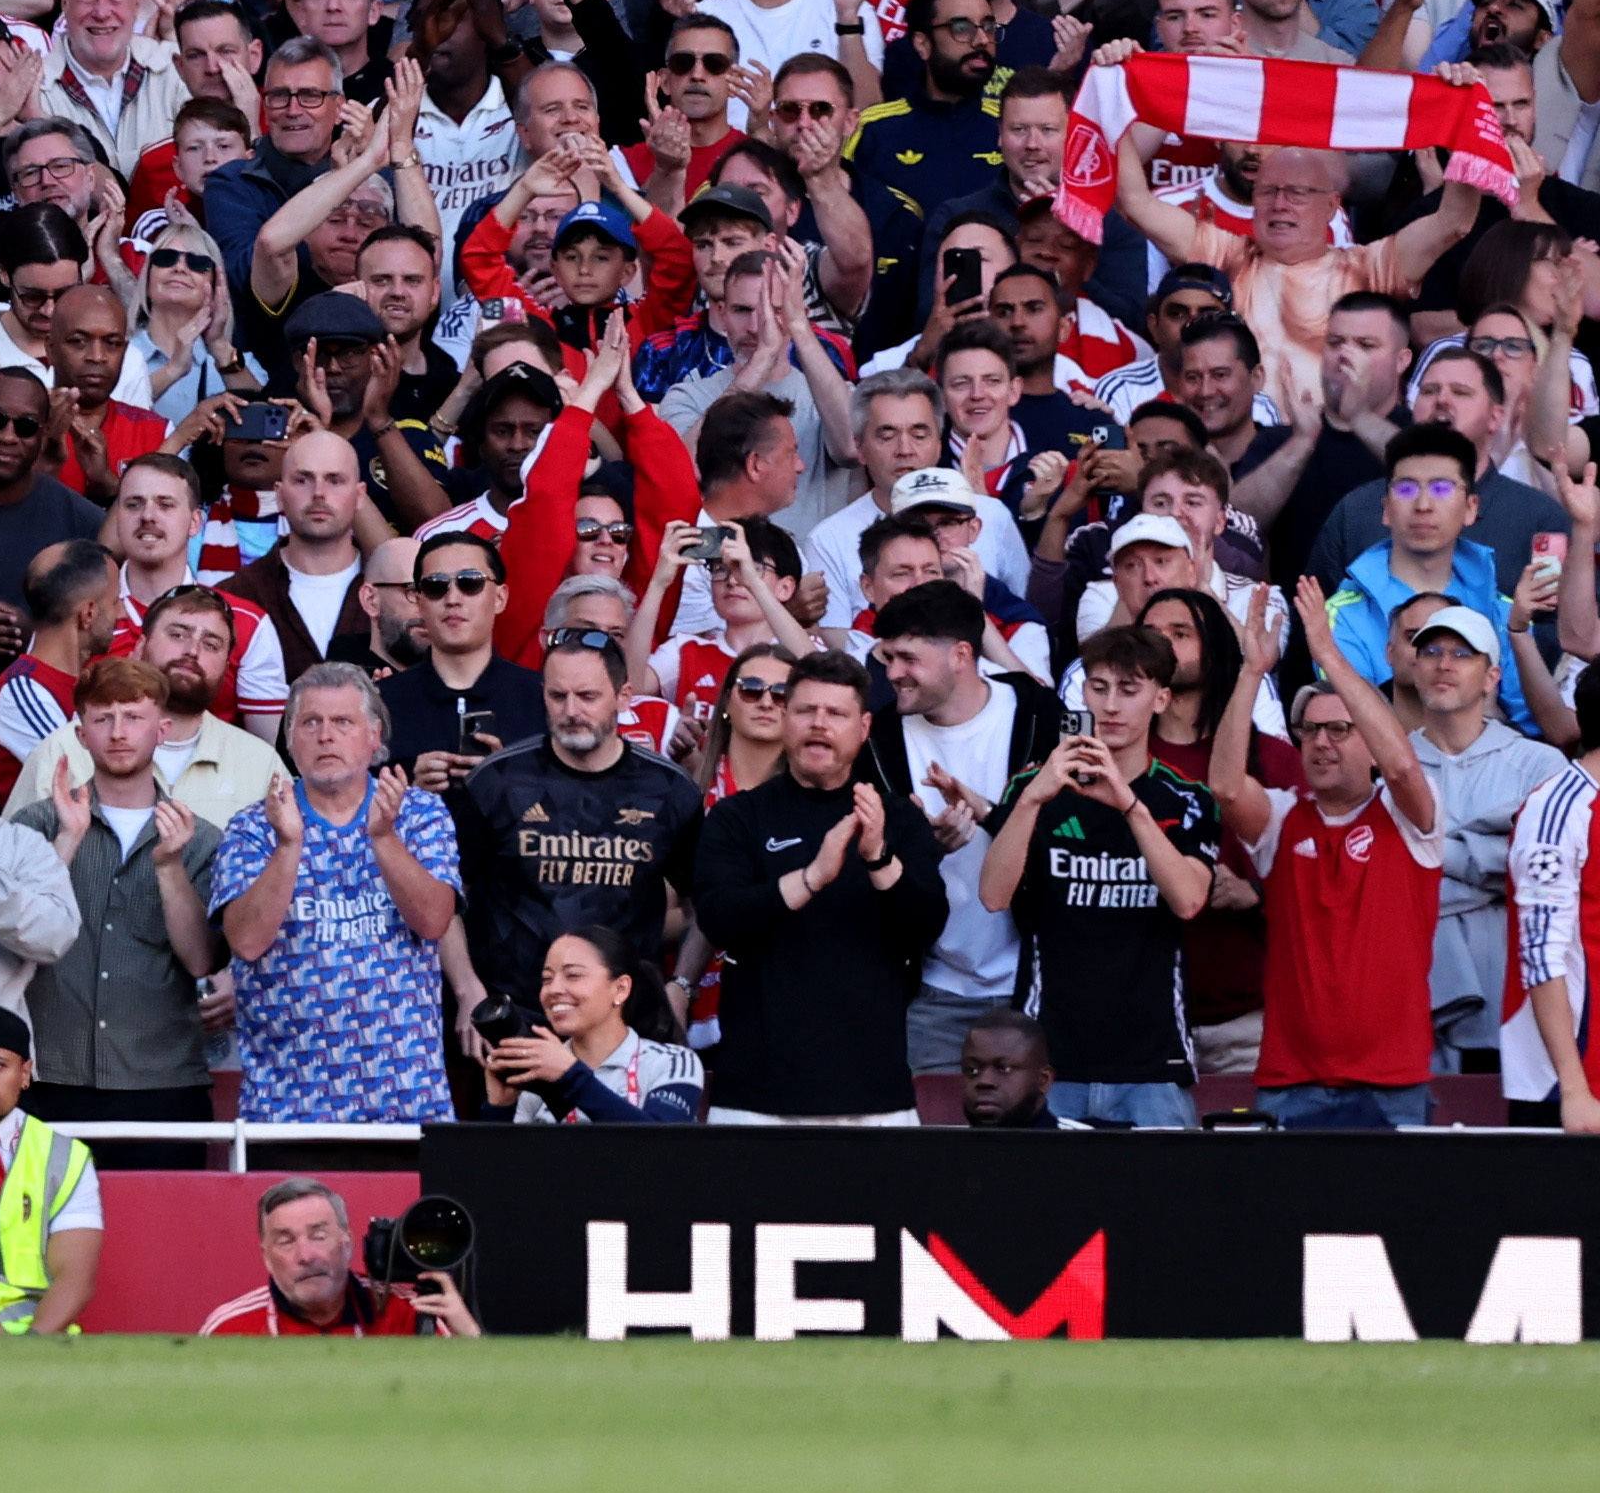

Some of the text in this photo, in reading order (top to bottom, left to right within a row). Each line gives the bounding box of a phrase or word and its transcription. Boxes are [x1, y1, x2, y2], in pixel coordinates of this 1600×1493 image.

[421, 154, 511, 189] mirates
[518, 830, 653, 863] Emirates
[539, 860, 635, 888] FLY BETTER
[1049, 848, 1145, 882] Emirat
[1067, 882, 1096, 907] FLY
[314, 914, 388, 942] FLY BETTER
